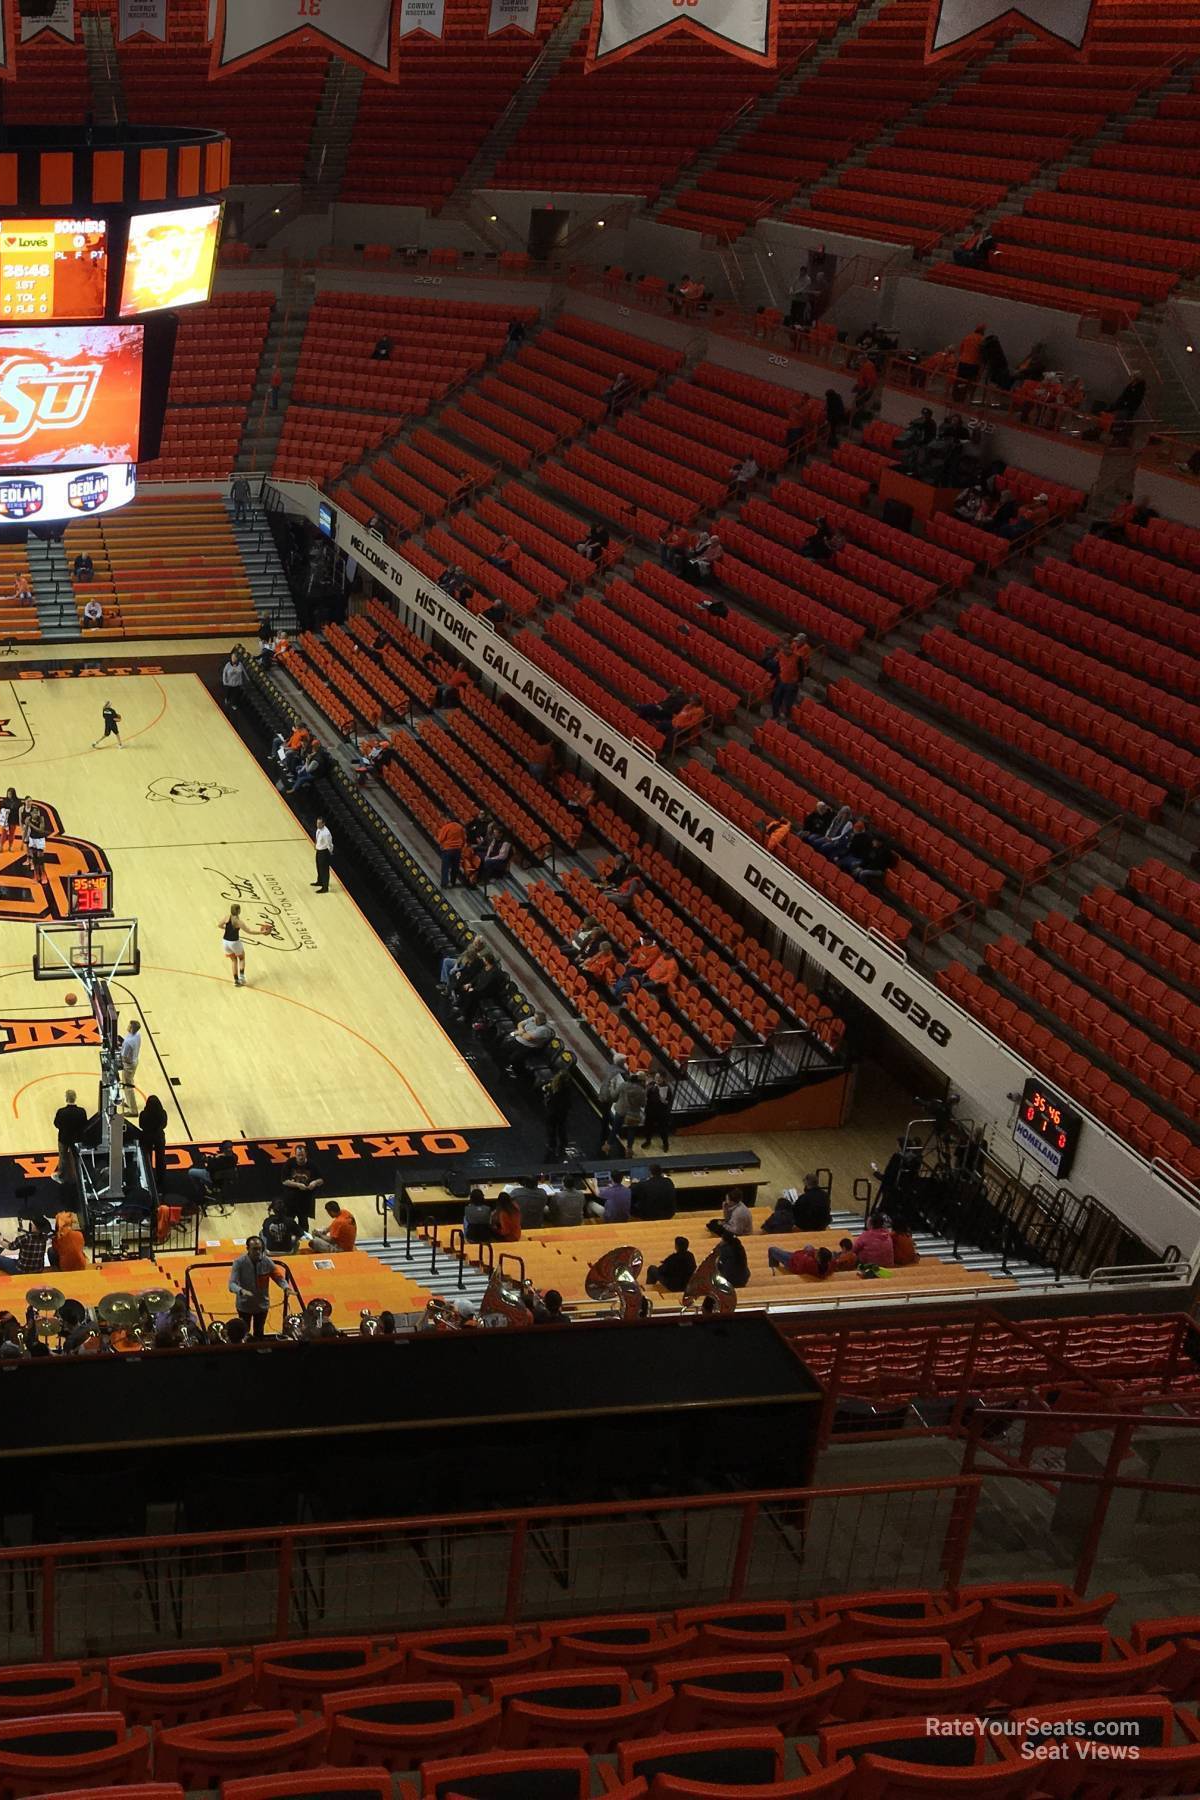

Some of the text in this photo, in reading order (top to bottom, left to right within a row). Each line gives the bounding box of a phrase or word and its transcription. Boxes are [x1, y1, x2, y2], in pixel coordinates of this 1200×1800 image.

[54, 220, 106, 233] SOONERS
[73, 235, 86, 247] 0
[54, 250, 105, 260] PL F PT
[413, 275, 442, 285] 220
[4, 305, 12, 314] 0
[39, 304, 47, 313] 0
[69, 477, 109, 498] BEDLAM
[18, 666, 165, 680] STATE
[350, 533, 389, 576] WELCOME
[390, 567, 404, 586] TO
[414, 588, 478, 652] HISTORIC
[634, 775, 715, 853] ARENA
[743, 862, 878, 986] DEDICATED
[880, 979, 953, 1049] 1938
[74, 877, 108, 890] 35:46
[78, 890, 103, 910] 30
[263, 874, 318, 950] EDDIE SUTTON COURT
[1016, 1123, 1059, 1166] HOMELAND
